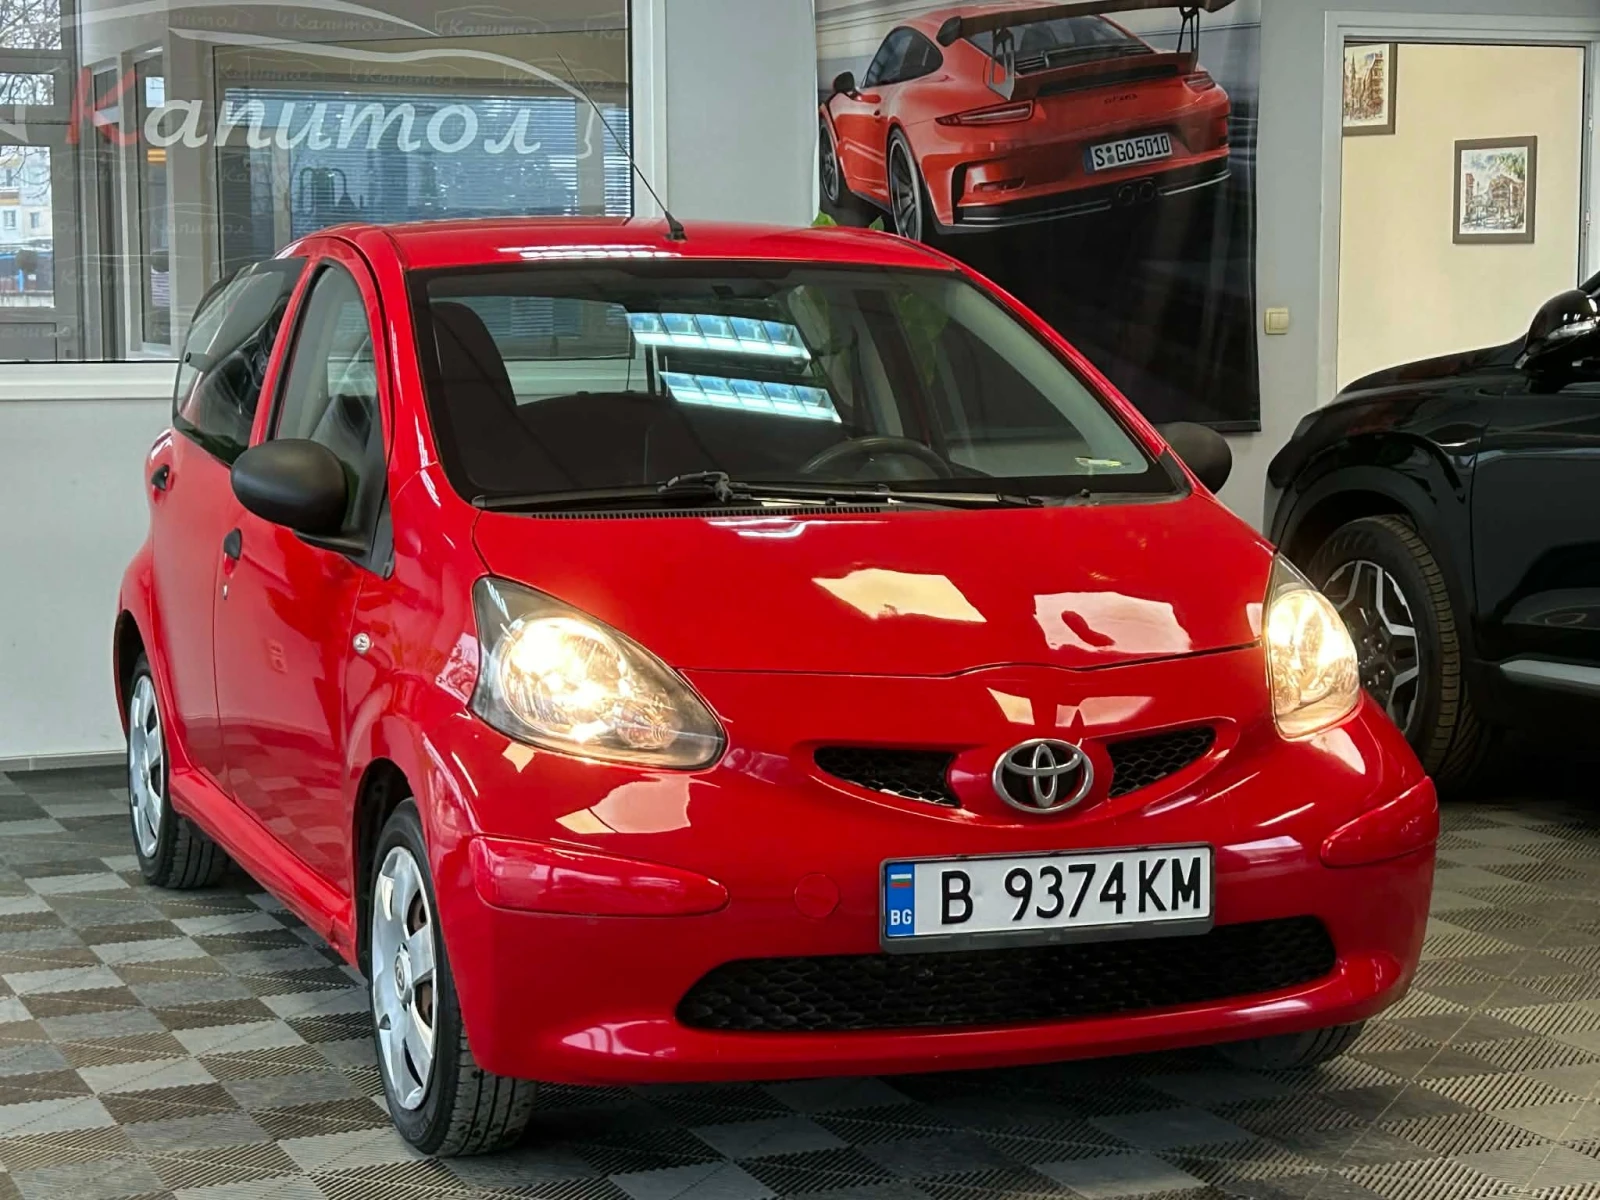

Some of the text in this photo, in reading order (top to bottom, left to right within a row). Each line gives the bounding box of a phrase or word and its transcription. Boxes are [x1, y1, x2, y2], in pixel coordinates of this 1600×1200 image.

[66, 66, 542, 155] Капитол
[890, 908, 913, 926] BG
[941, 870, 974, 925] B
